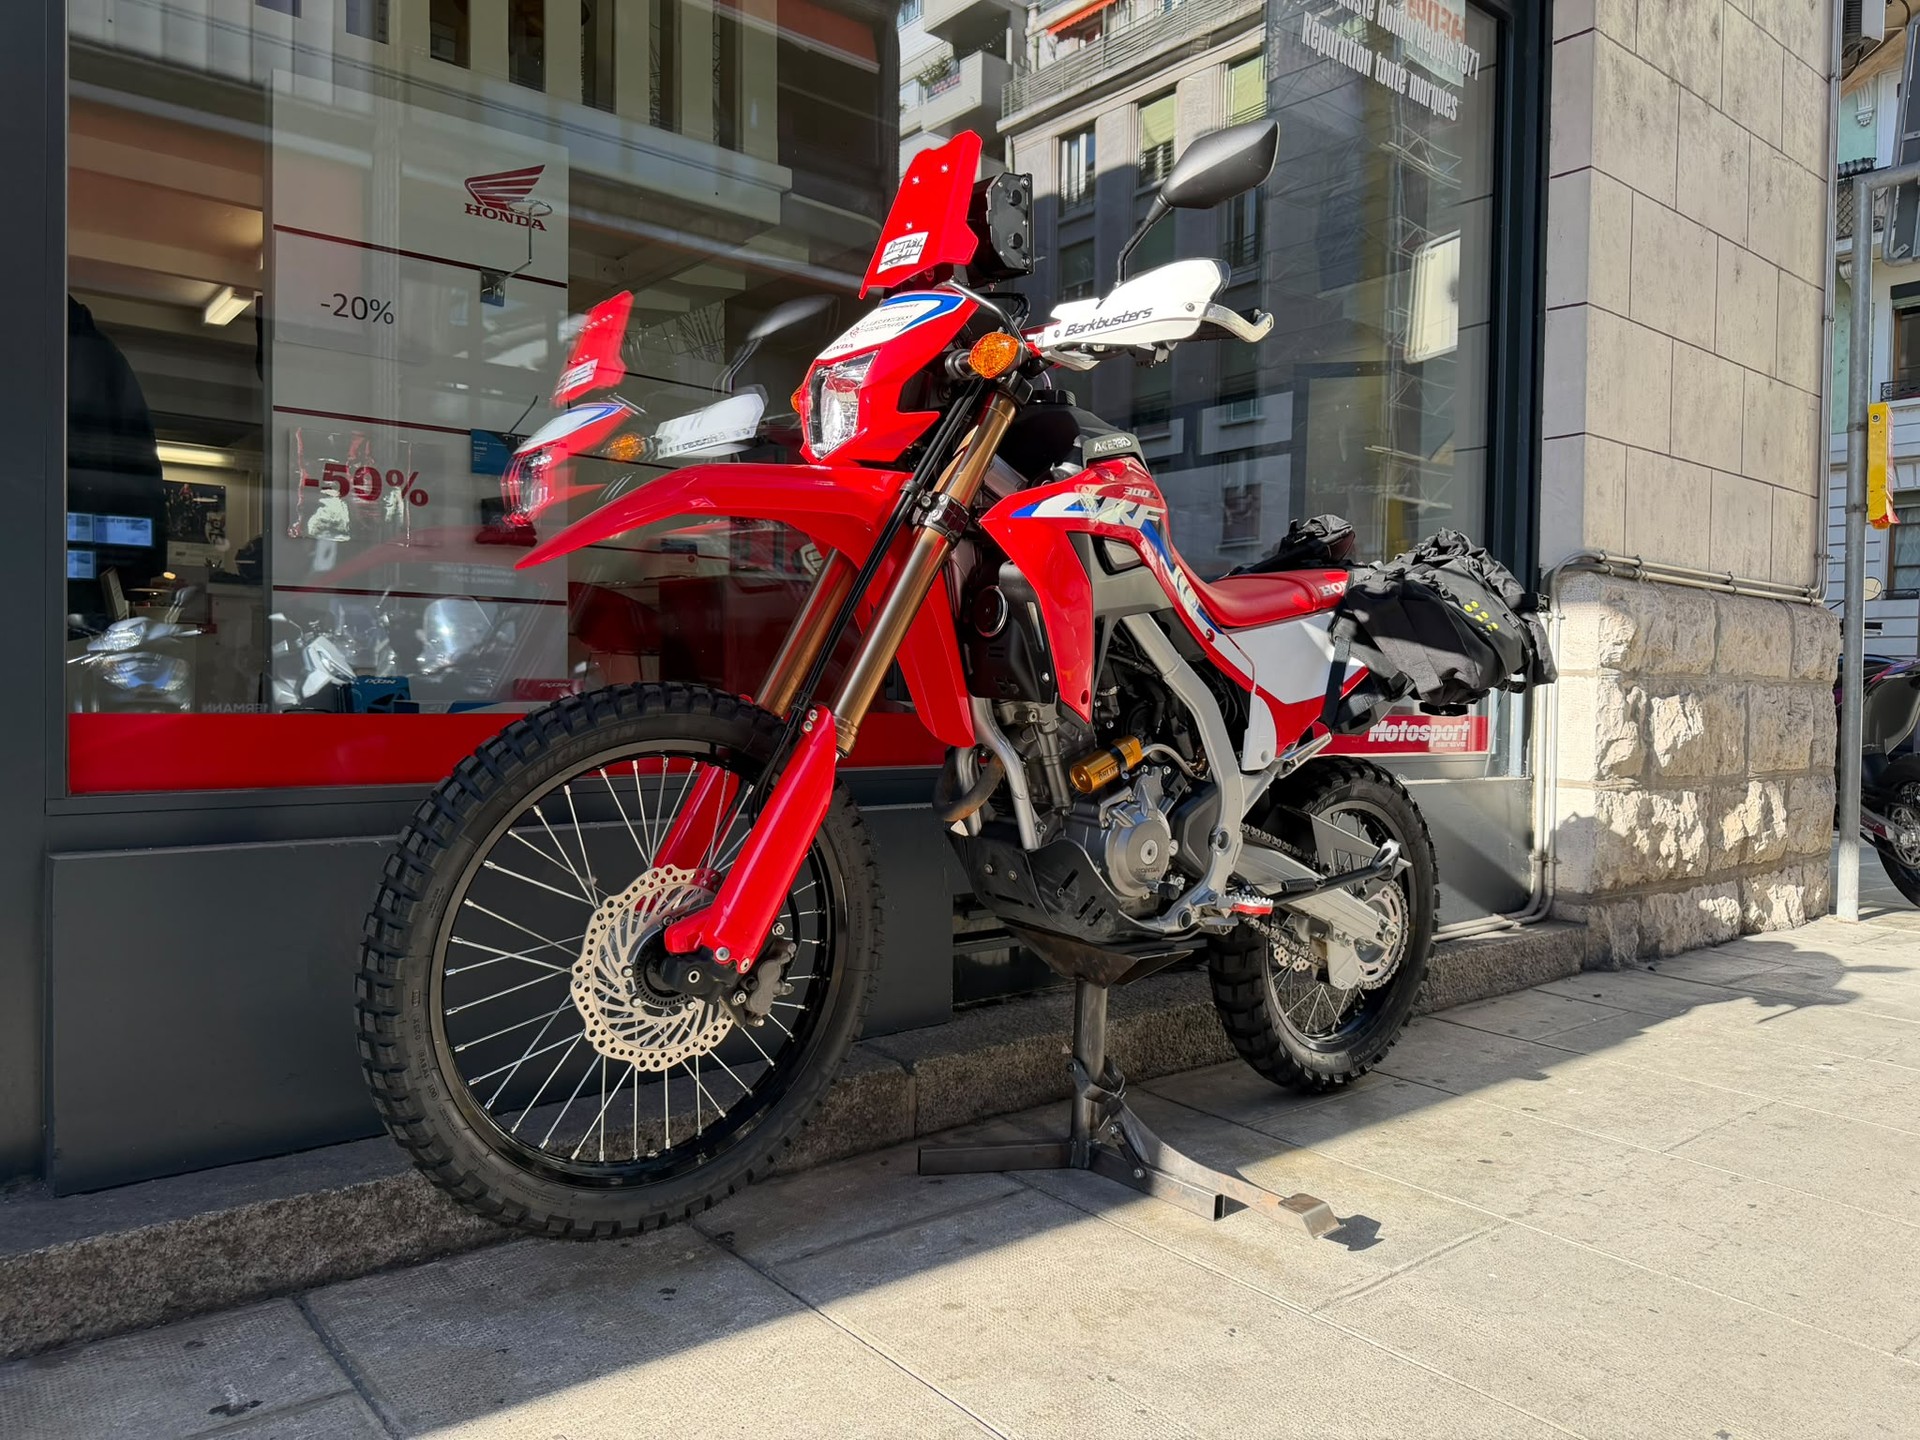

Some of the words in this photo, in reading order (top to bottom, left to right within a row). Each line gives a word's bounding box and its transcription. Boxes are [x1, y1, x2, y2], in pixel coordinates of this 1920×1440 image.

[1301, 11, 1373, 78] Réparation
[1374, 51, 1407, 95] toute
[1408, 72, 1458, 121] marques
[1416, 20, 1454, 66] depuis
[1457, 42, 1481, 81] 1971
[464, 202, 548, 232] HONDA
[320, 292, 395, 325] -20%
[1064, 306, 1154, 338] Barkbusters
[303, 461, 430, 508] -50%
[1367, 720, 1470, 749] Motosport
